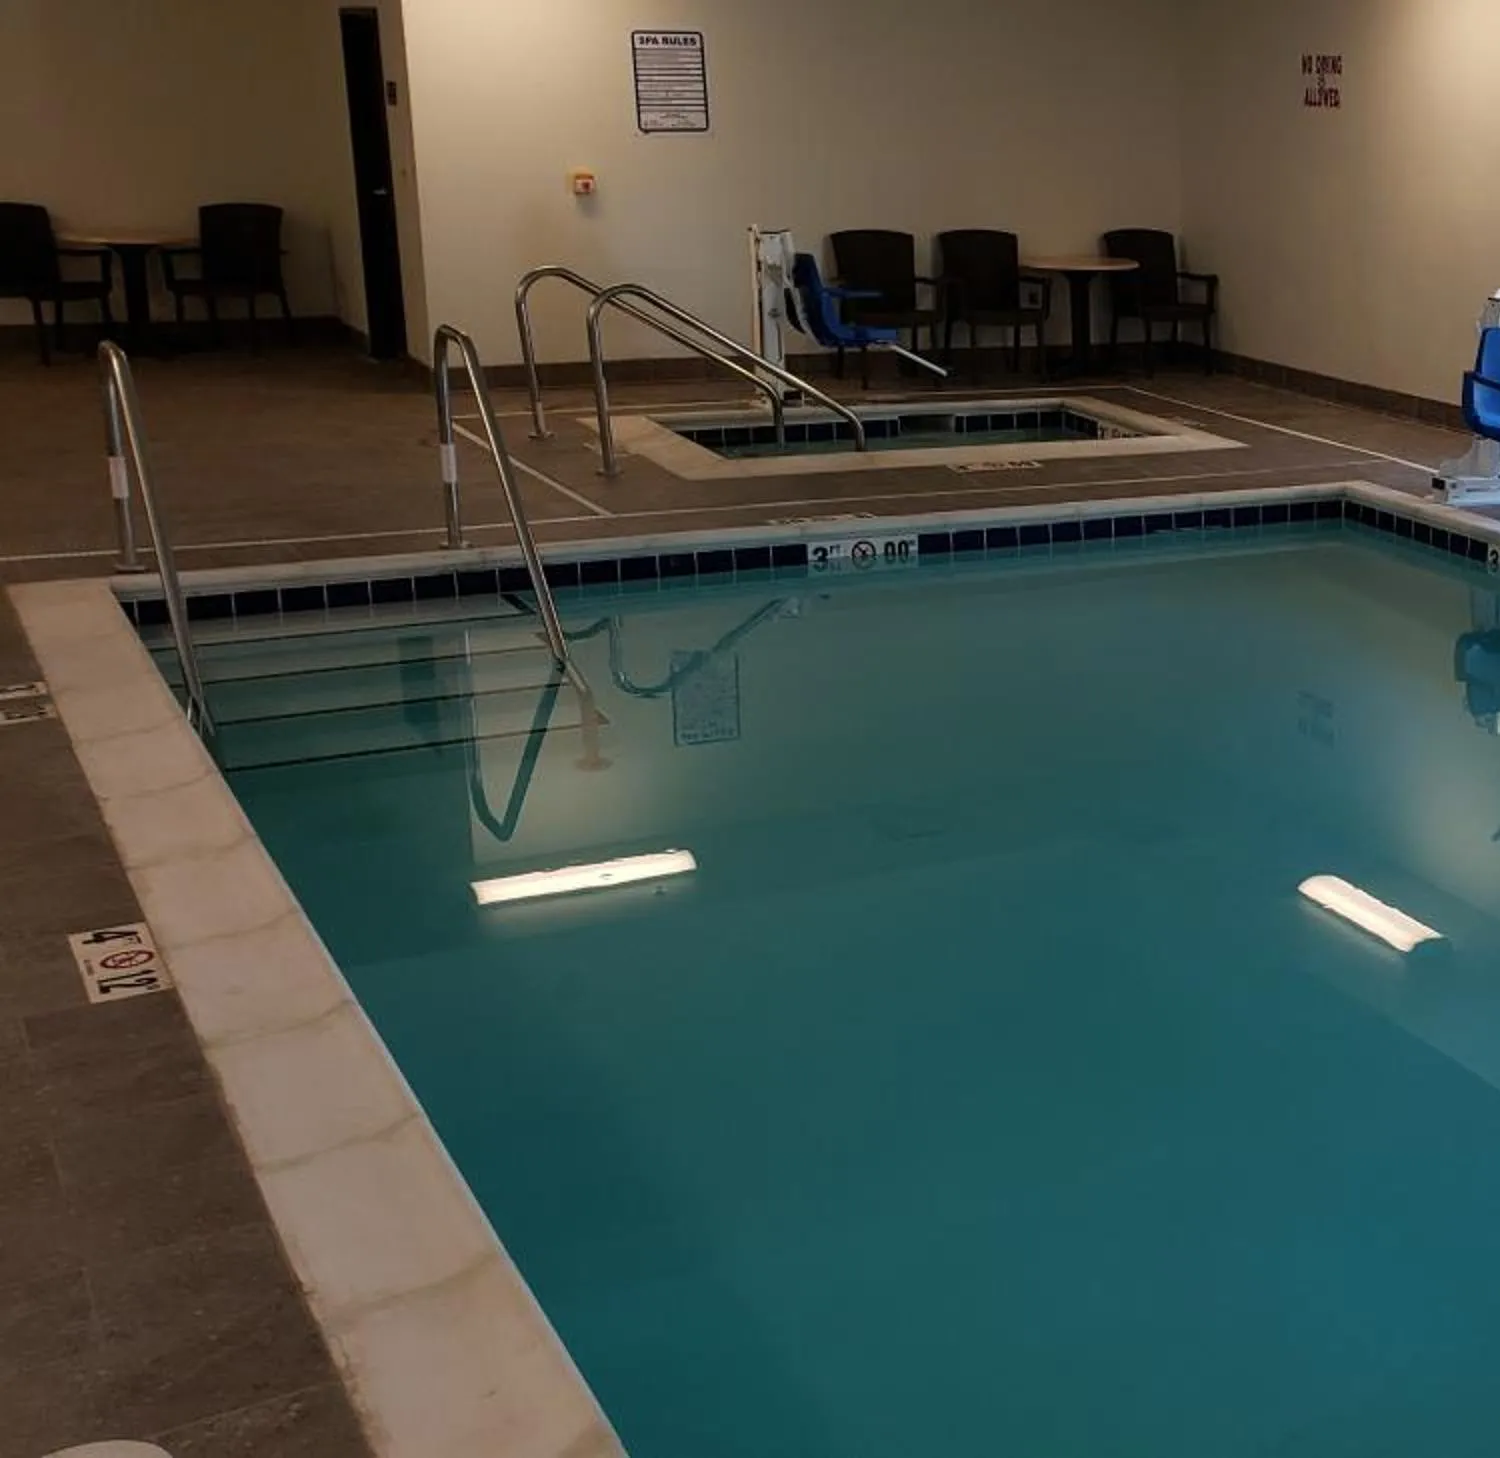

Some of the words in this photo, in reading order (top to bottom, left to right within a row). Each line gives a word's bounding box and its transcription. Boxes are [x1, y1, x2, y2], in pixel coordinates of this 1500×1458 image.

[638, 35, 660, 46] SPA
[661, 36, 698, 46] RULES
[1301, 55, 1313, 75] NO
